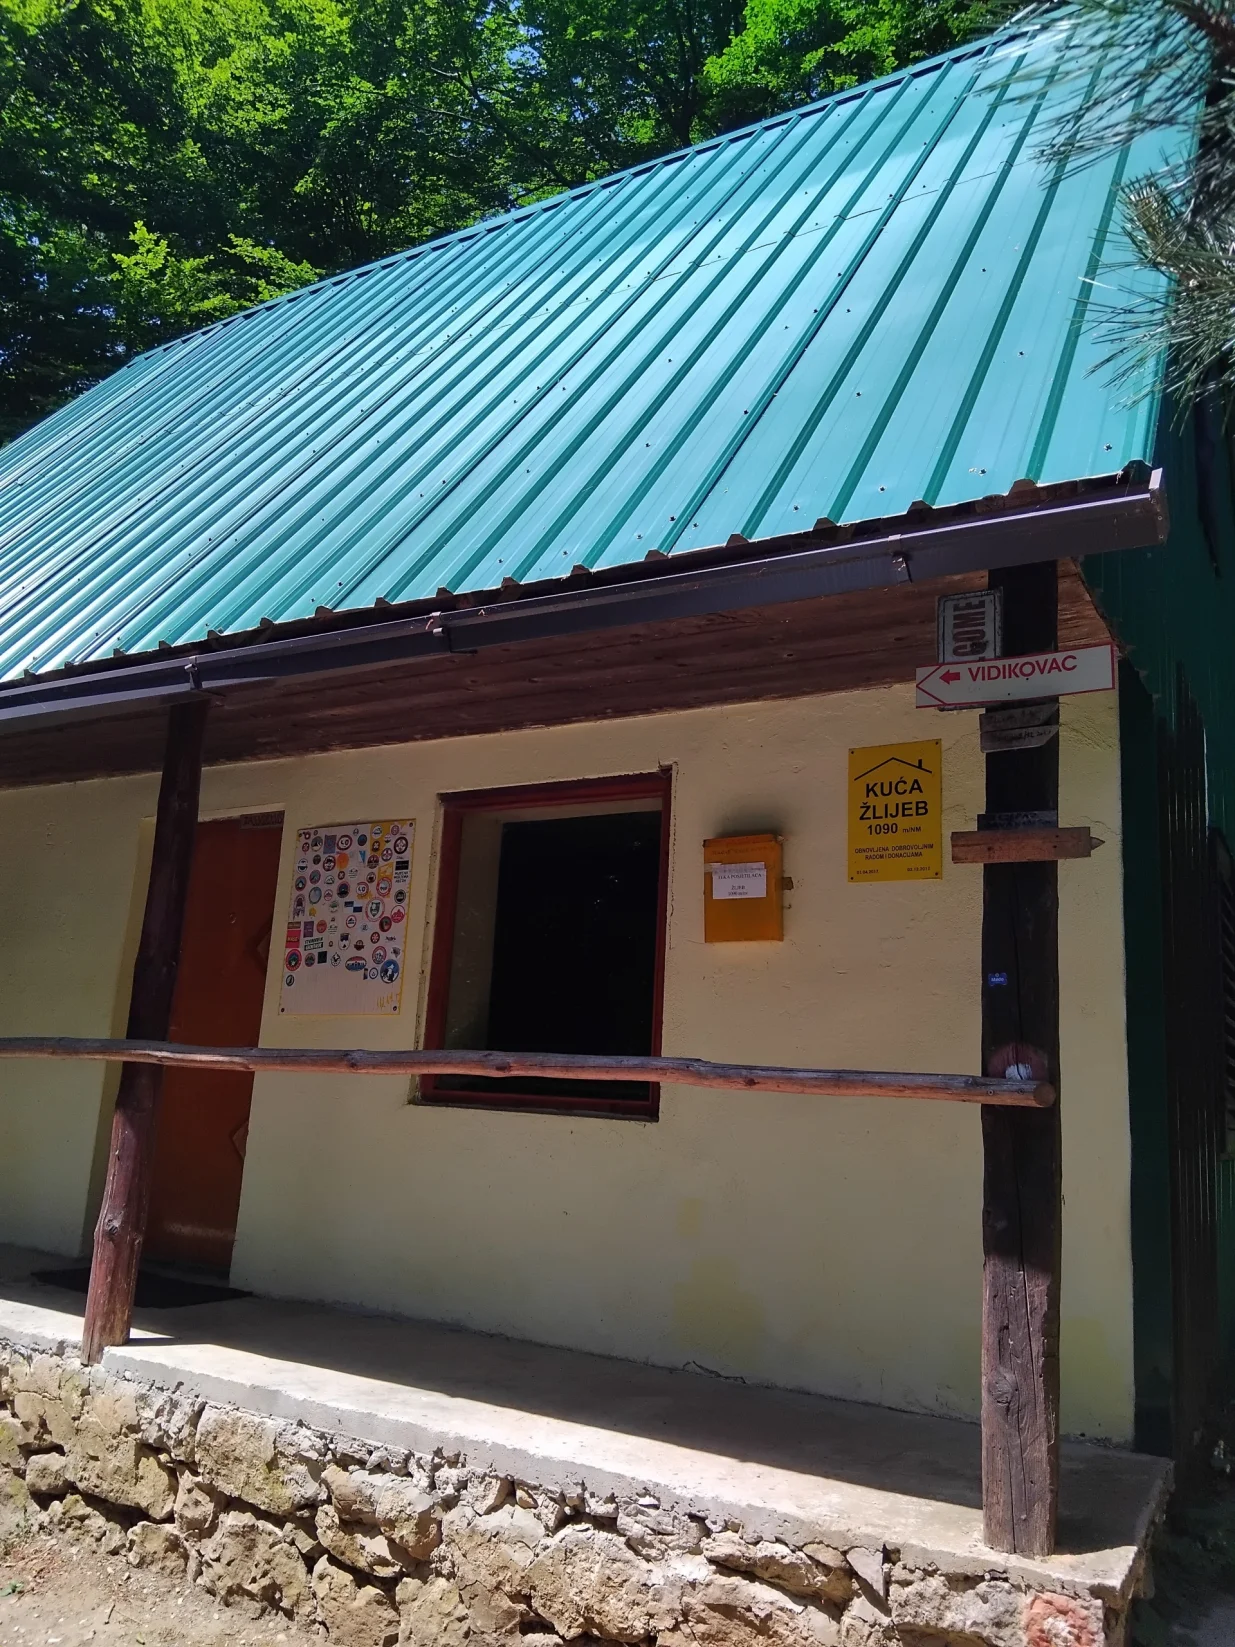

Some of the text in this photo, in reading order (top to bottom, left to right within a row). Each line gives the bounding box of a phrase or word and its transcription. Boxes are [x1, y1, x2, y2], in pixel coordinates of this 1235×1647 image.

[968, 655, 1077, 682] VIDIKOVAC
[866, 776, 923, 798] KUĆA
[859, 801, 929, 820] ŽLIJEB
[867, 823, 898, 835] 1090
[855, 843, 934, 854] OBNOVLJENA DOBROVOLJNIM
[887, 851, 923, 859] DONACIJAMA
